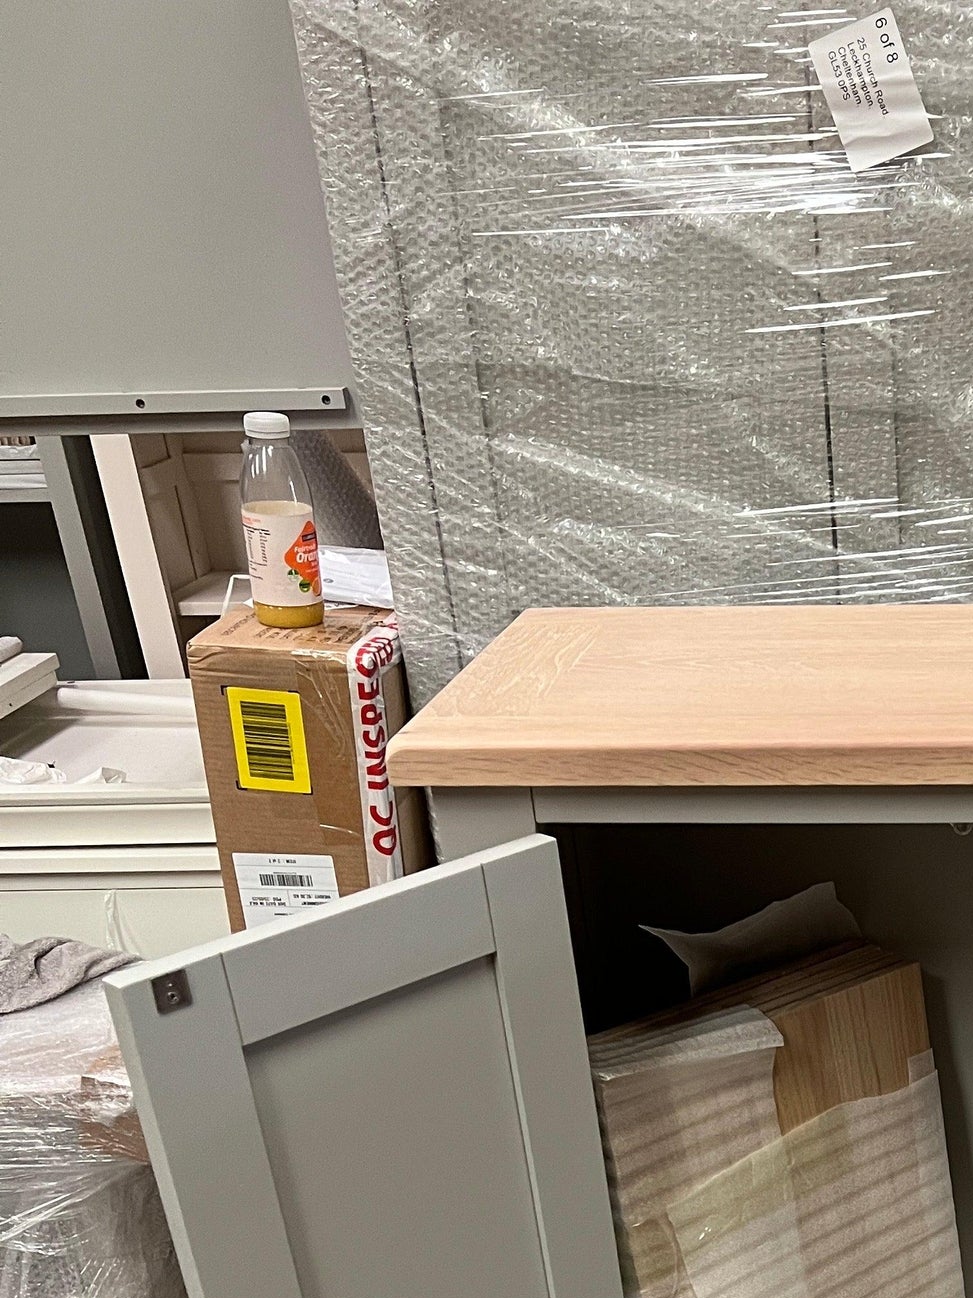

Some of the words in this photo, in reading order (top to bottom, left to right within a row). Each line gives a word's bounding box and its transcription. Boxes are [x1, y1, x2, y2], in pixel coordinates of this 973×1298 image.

[875, 17, 888, 29] 6
[880, 33, 896, 48] of
[828, 50, 843, 78] GL53
[856, 36, 868, 51] 25
[862, 52, 879, 89] Church
[886, 52, 899, 63] 8
[369, 799, 398, 857] QC
